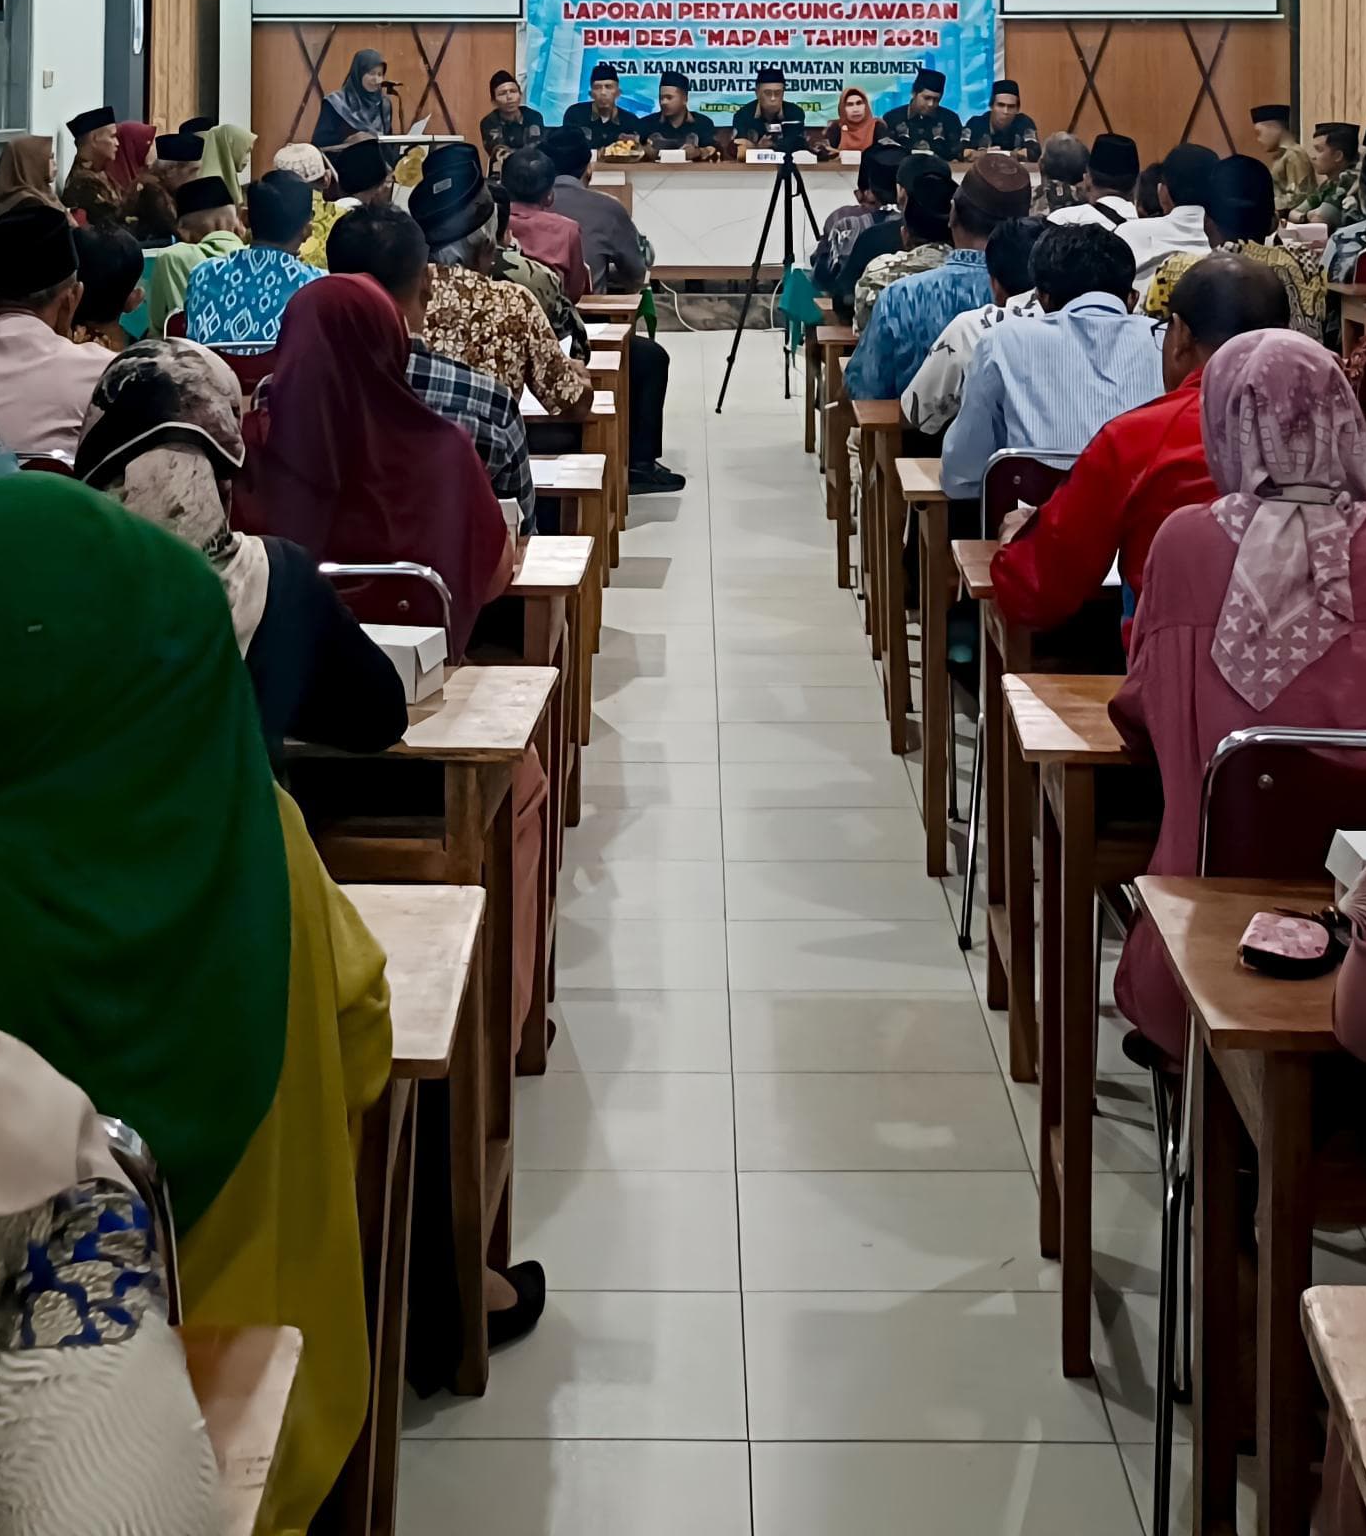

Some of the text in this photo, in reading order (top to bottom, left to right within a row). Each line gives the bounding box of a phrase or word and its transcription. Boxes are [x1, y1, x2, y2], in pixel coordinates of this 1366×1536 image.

[563, 2, 959, 20] LAPORAN PERTANGGUNGJAWABAN
[584, 28, 939, 46] BUM DESA "MAPAN" TAHUN 2024
[643, 60, 743, 74] KARANGSARI
[850, 61, 923, 74] KEBUMEN
[687, 78, 844, 92] ABUPATE EBUMEN
